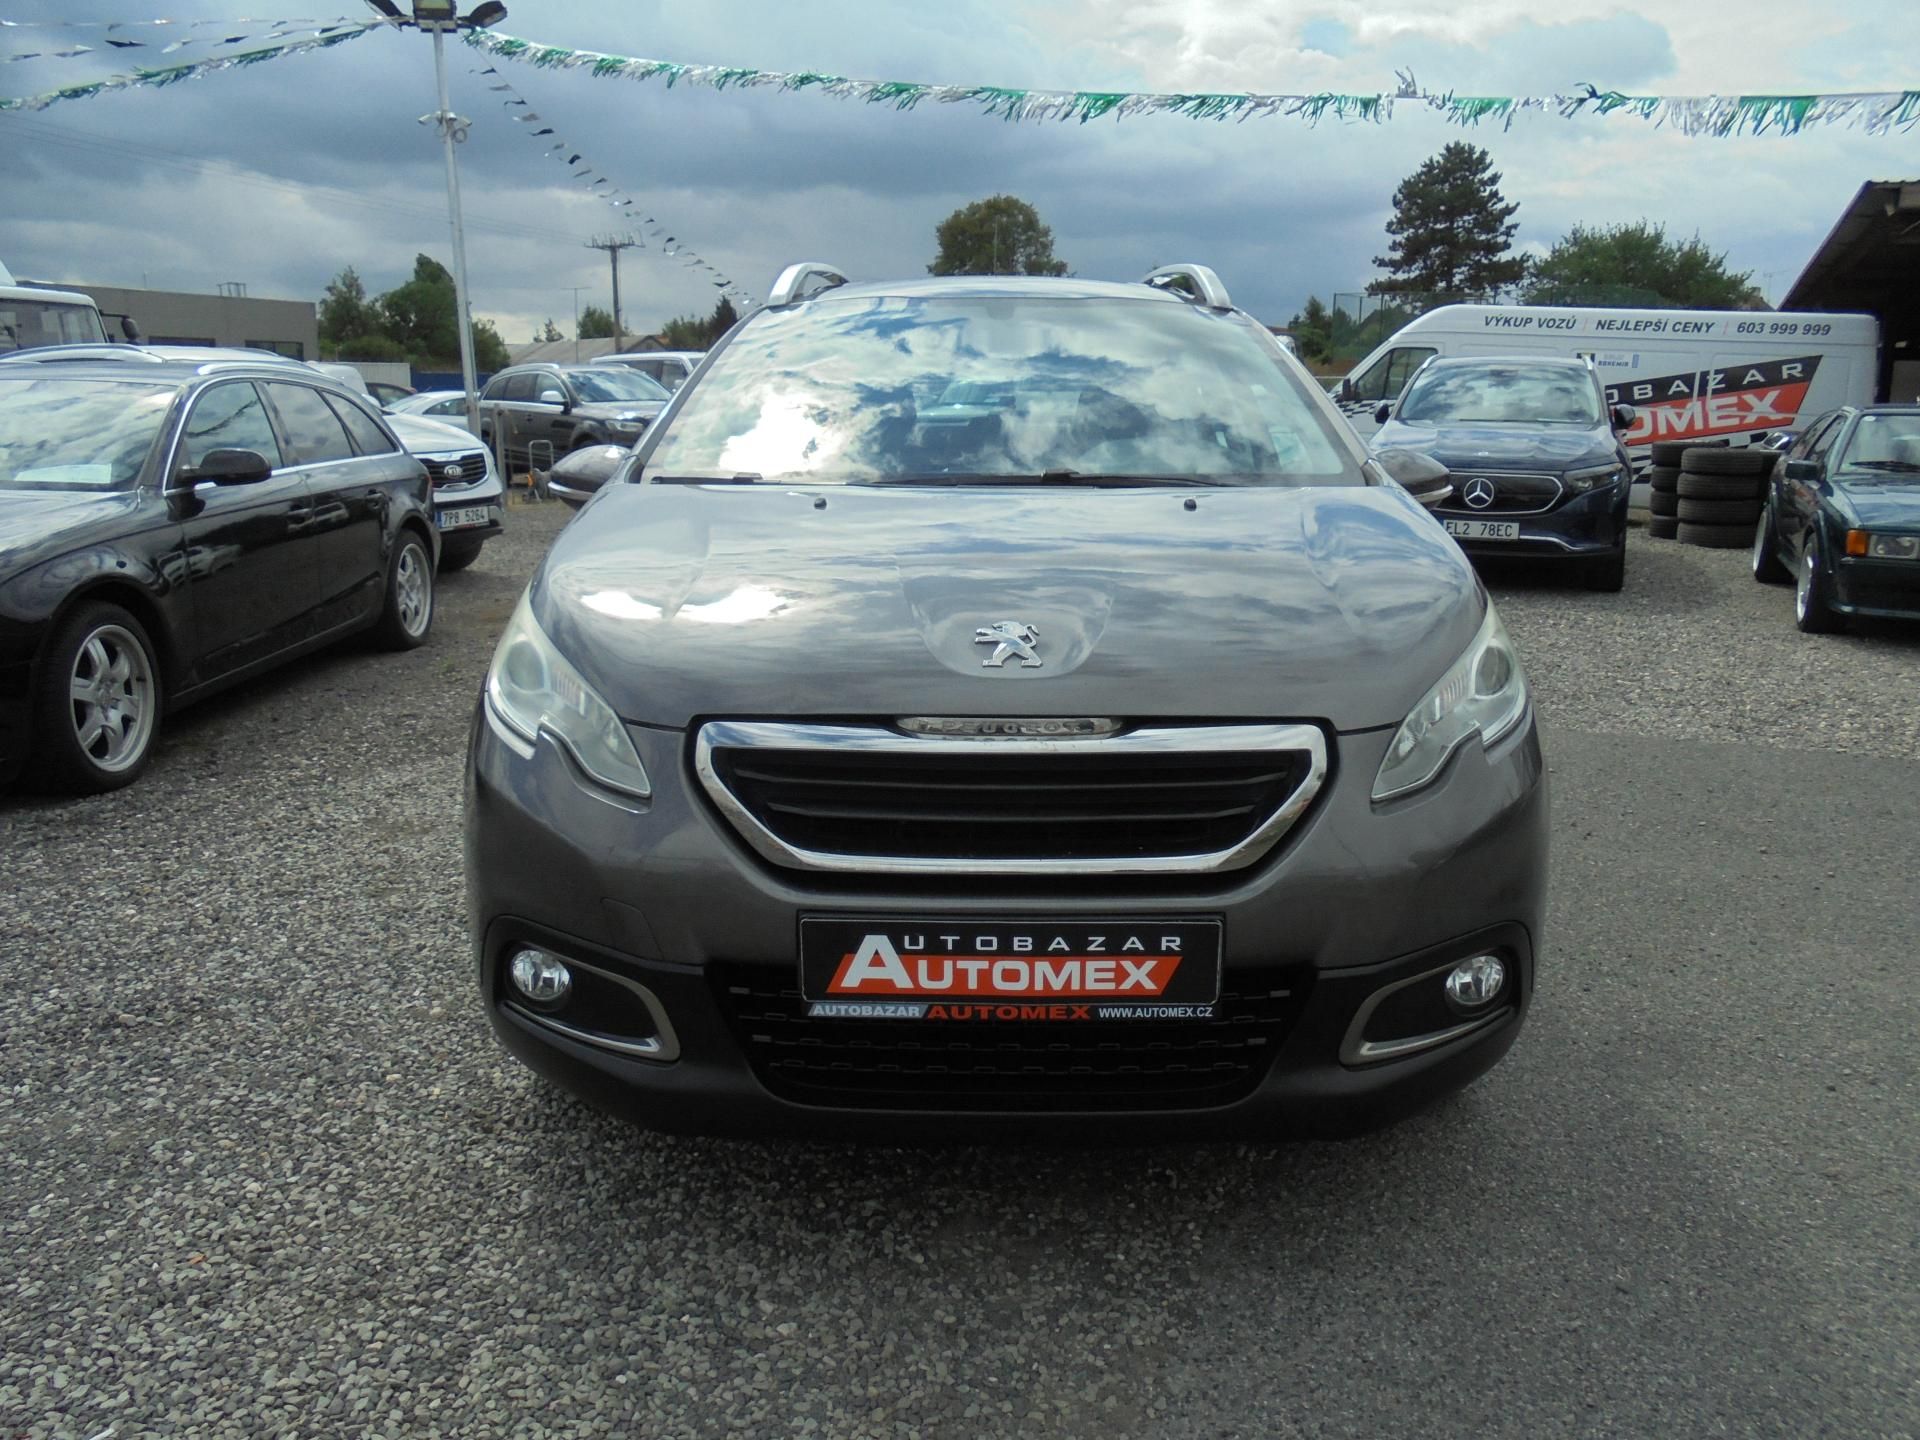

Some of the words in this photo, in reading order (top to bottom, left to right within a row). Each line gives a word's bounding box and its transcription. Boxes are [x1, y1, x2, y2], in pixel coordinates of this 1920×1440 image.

[1484, 314, 1533, 328] VÝKUP
[1595, 318, 1669, 332] NEJLEPŠÍ
[1672, 321, 1716, 334] CENY
[1737, 321, 1765, 334] 603
[1769, 322, 1798, 335] 999
[1802, 323, 1831, 336] 999
[1480, 523, 1513, 537] 78EC
[840, 934, 1158, 991] AUTOMEX
[812, 1004, 921, 1018] AUTOBAZAR
[927, 1004, 1091, 1020] AUTOMEX
[1098, 1007, 1214, 1019] WWW.AUTOMEX.CZ
